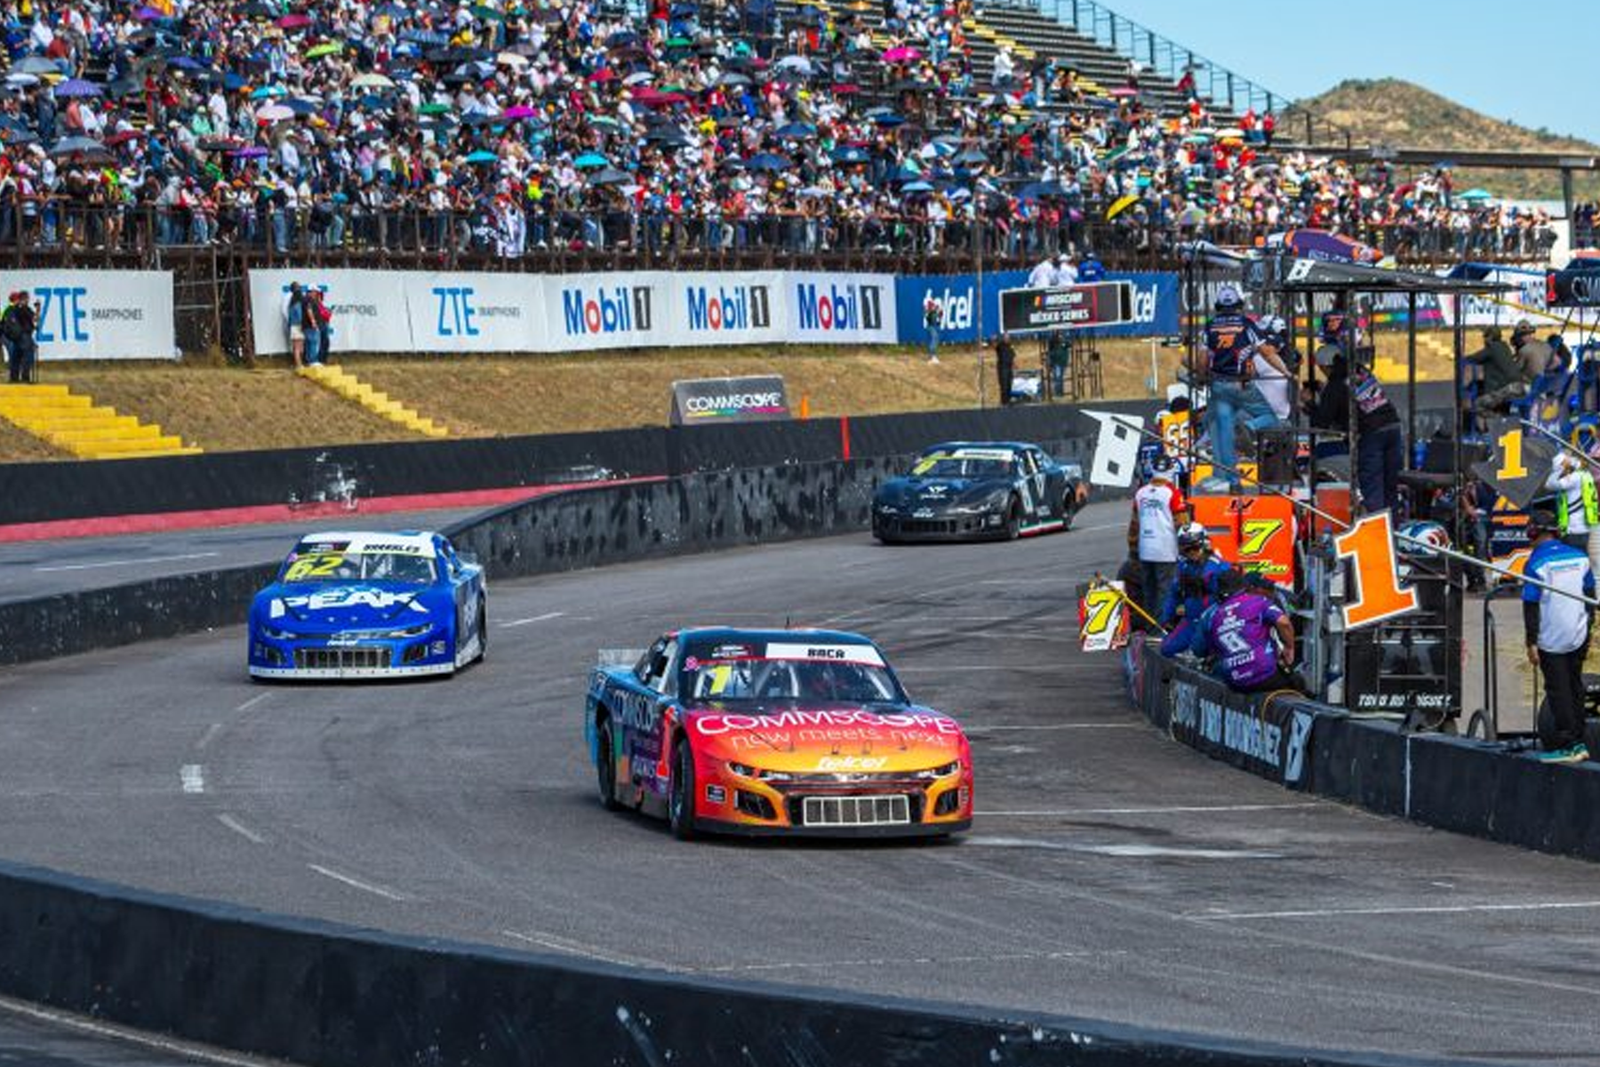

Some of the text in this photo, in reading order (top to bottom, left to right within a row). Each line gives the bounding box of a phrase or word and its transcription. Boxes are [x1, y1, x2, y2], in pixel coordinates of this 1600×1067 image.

[34, 287, 89, 342] ZTE
[432, 287, 479, 336] ZTE
[562, 286, 651, 335] Mobil 1
[687, 285, 771, 331] Mobil 1
[797, 283, 882, 331] Mobil 1
[923, 286, 974, 331] tlcel
[686, 392, 781, 412] COMMSCOPE
[1496, 428, 1529, 480] 1
[1239, 520, 1284, 556] 7
[284, 553, 344, 581] 62
[1334, 509, 1418, 630] 1
[270, 591, 430, 619] PEAK
[1085, 590, 1124, 635] 7
[696, 710, 960, 736] COMMSCOPE
[731, 727, 948, 751] now meets next
